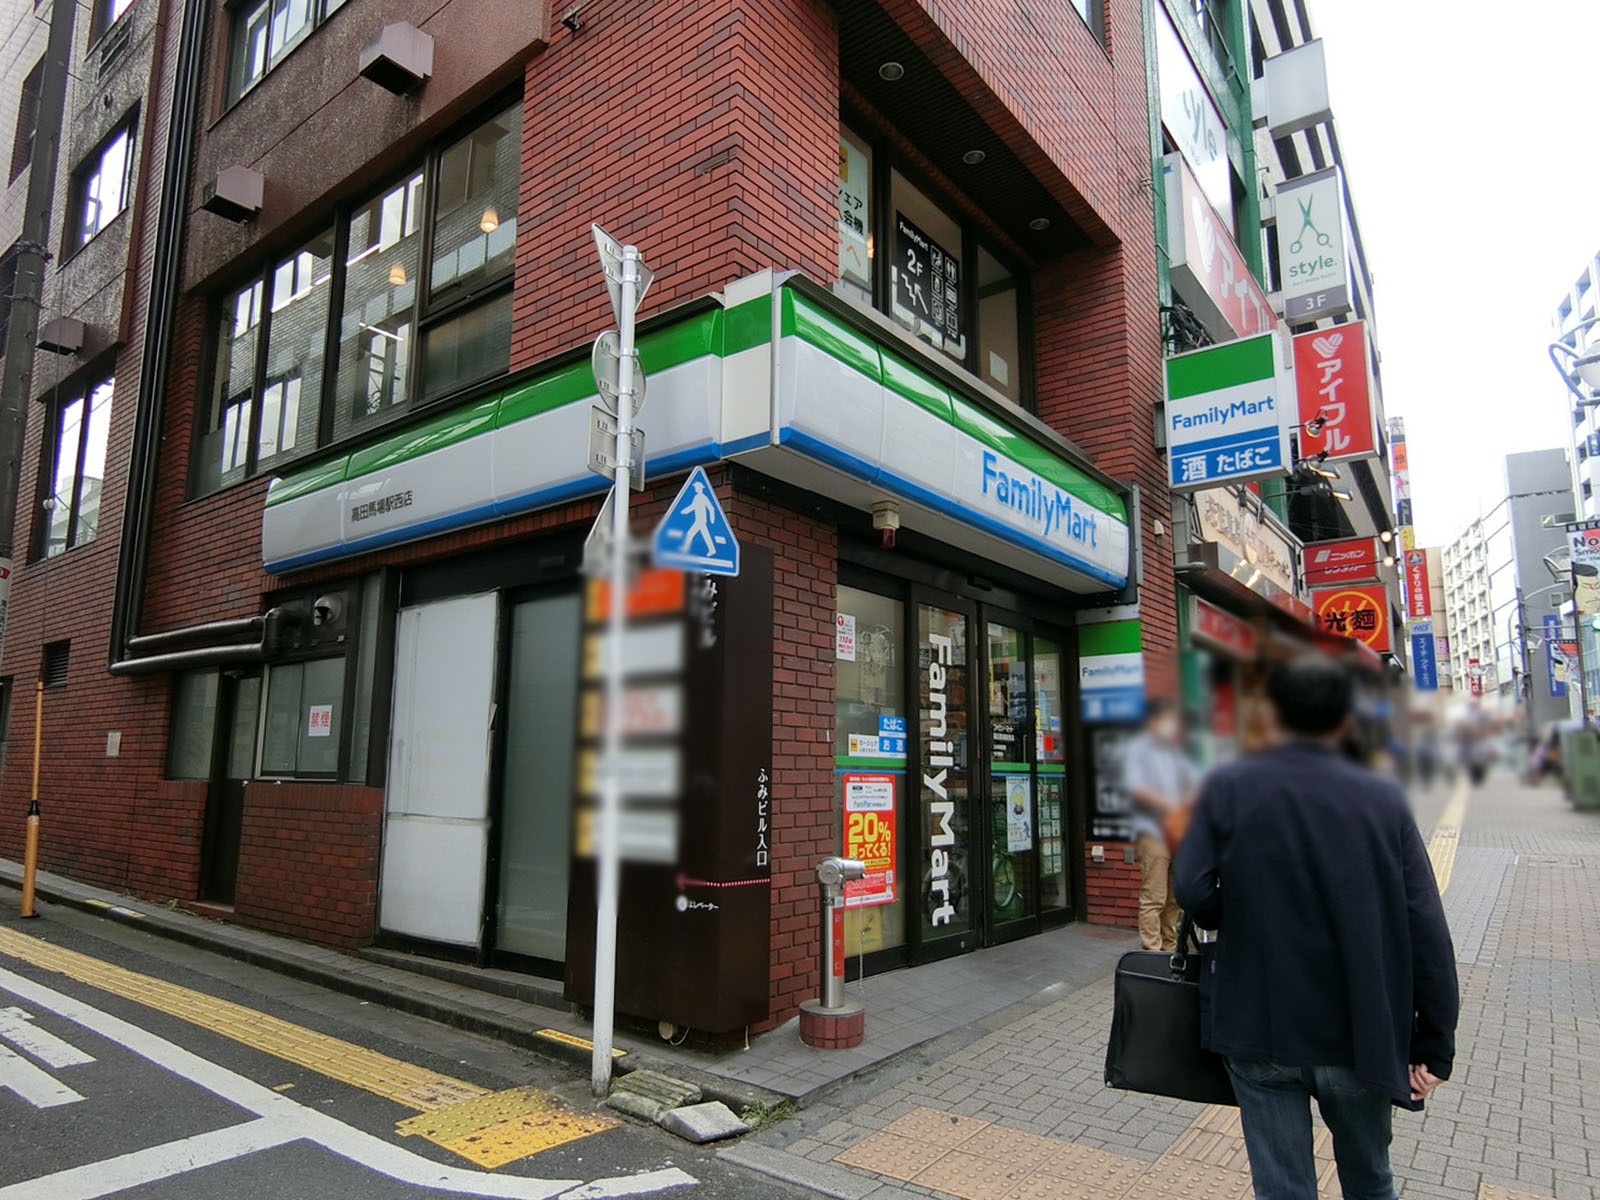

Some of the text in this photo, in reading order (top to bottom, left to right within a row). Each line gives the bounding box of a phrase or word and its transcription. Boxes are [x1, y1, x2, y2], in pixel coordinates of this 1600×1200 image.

[907, 248, 923, 277] 2F
[1172, 395, 1275, 431] FamilyMart
[1315, 358, 1350, 451] アイフル
[1181, 446, 1272, 481] 酒 たばこ
[351, 490, 413, 522] 高田馬場駅西店
[982, 449, 1097, 548] FamilyMart
[1330, 550, 1366, 561] ニッポン
[882, 716, 903, 731] たばこ
[925, 633, 956, 928] FamilyMart
[757, 768, 769, 867] ふみビル入口
[848, 812, 892, 844] 20%
